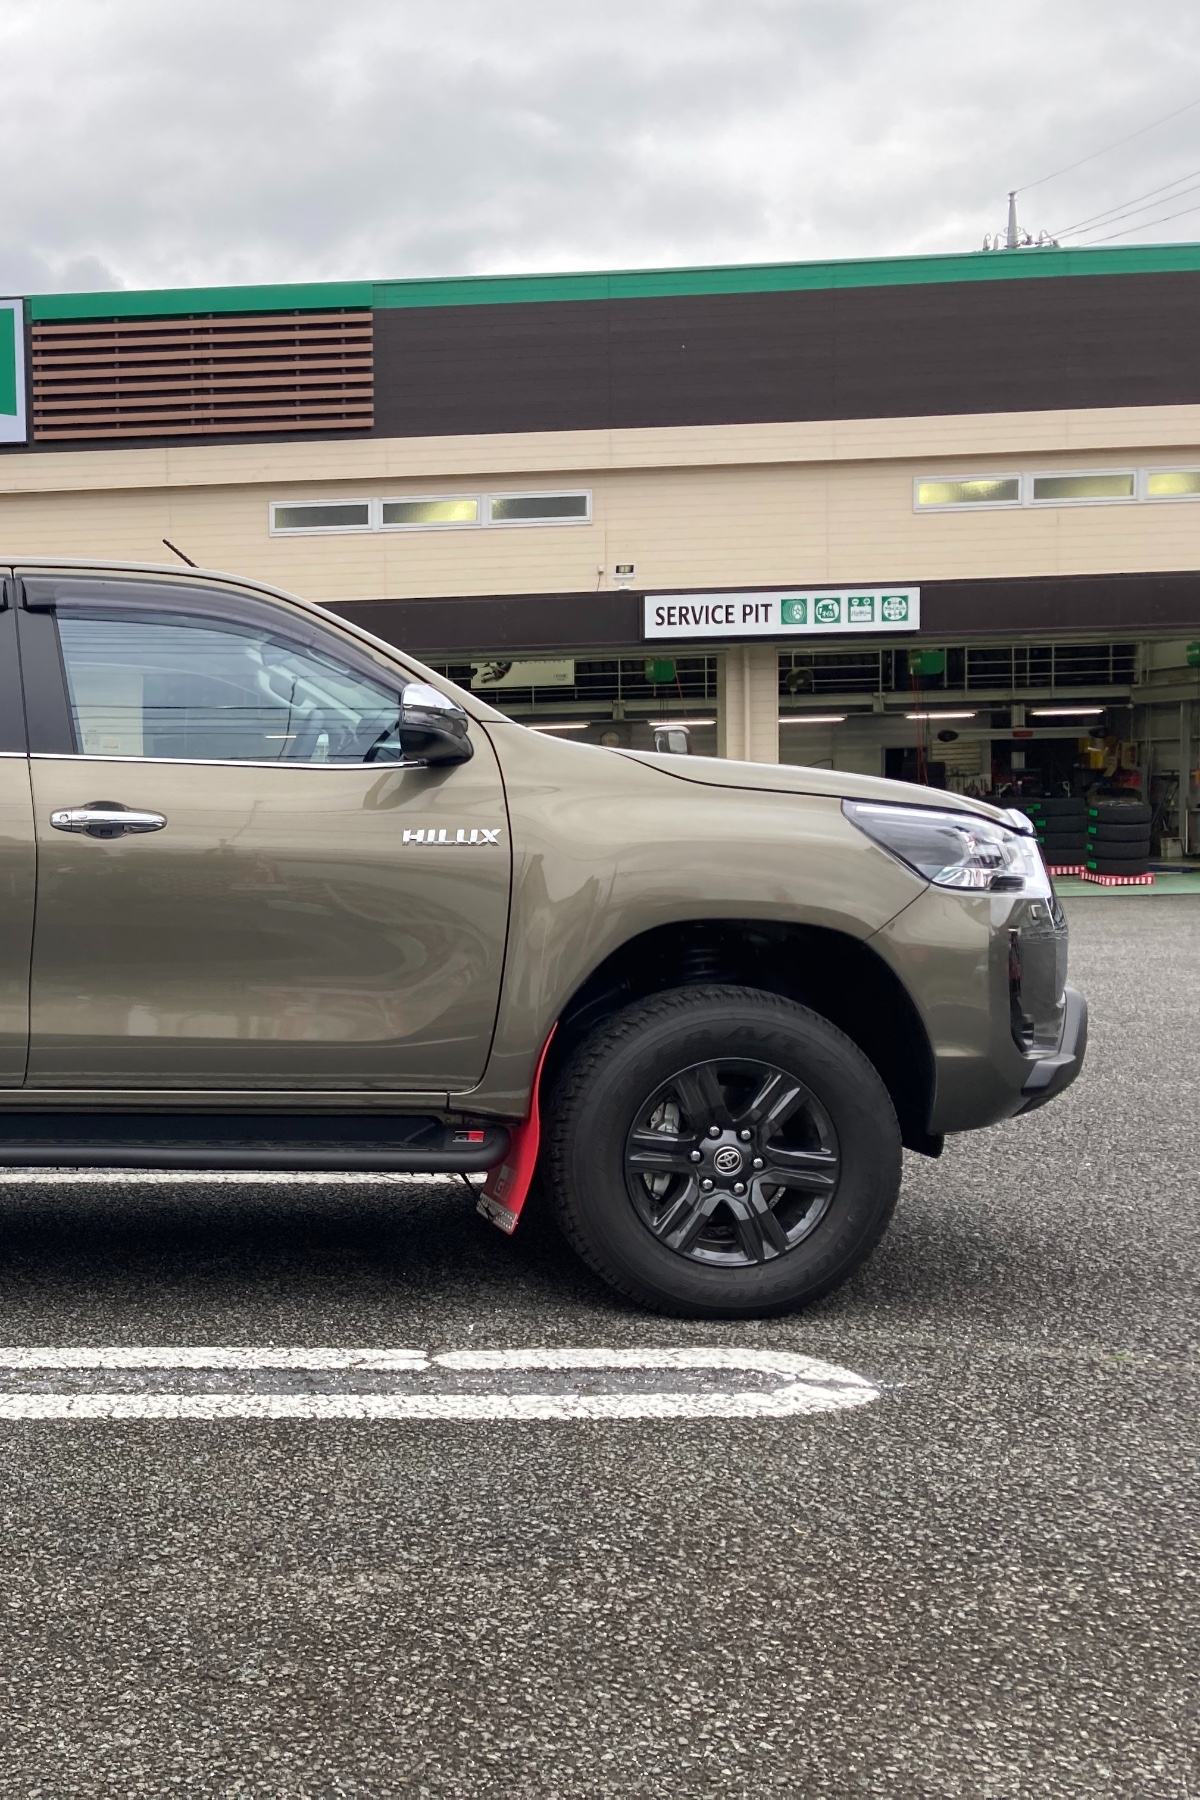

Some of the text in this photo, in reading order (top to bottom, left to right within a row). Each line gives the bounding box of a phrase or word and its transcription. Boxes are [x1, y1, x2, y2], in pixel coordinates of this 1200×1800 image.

[655, 603, 773, 626] SERVICE PIT
[402, 828, 502, 847] HILUX
